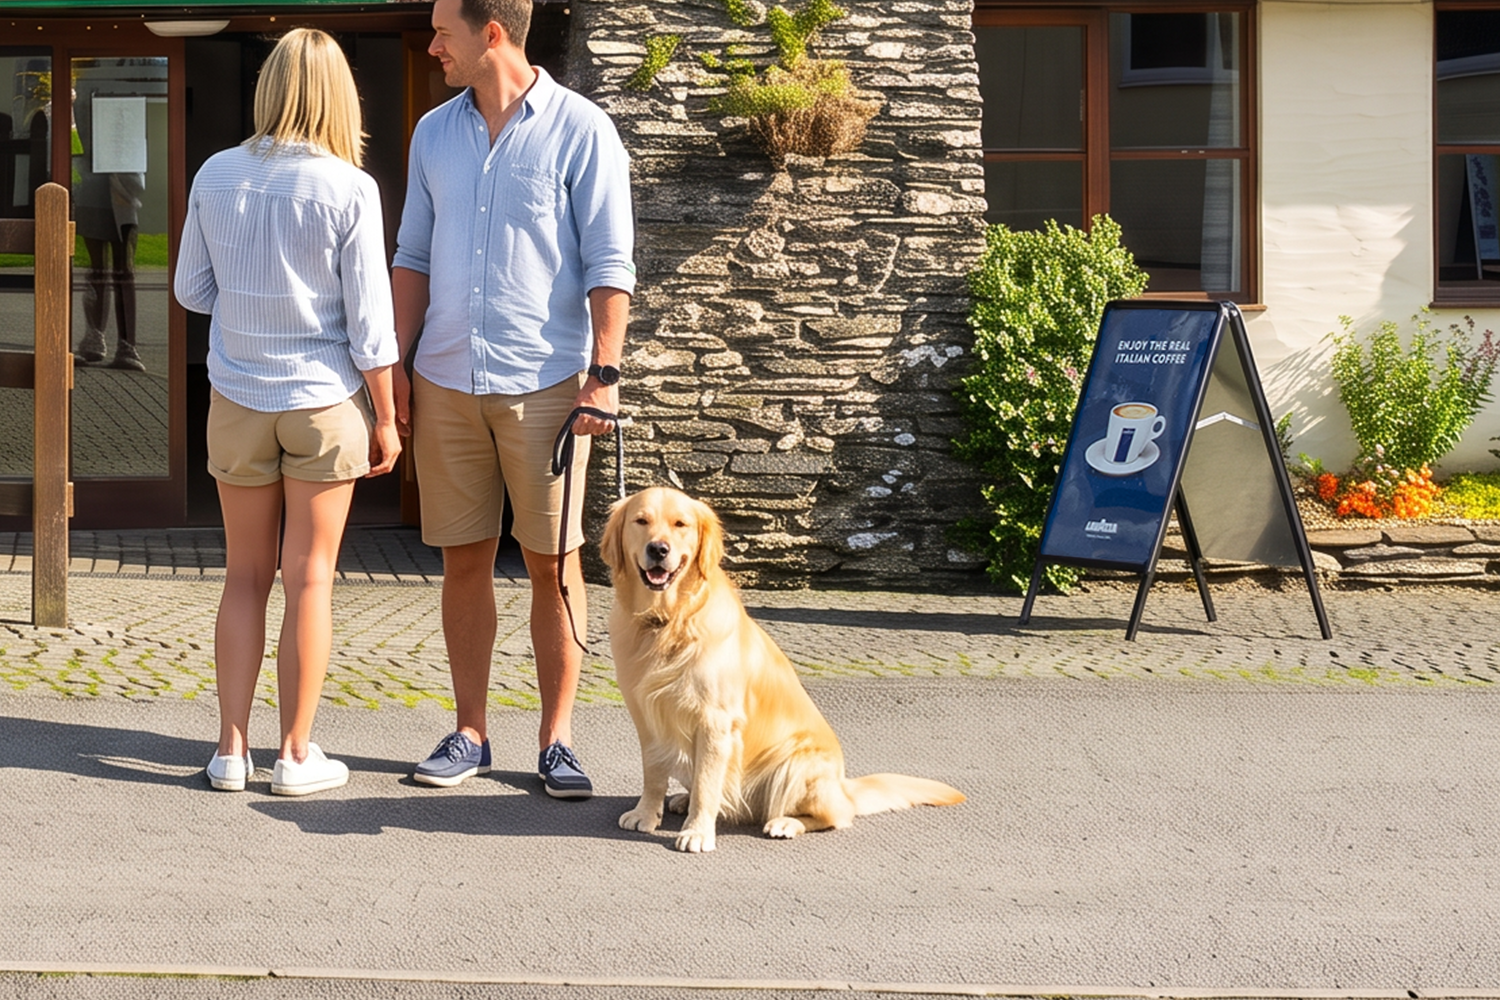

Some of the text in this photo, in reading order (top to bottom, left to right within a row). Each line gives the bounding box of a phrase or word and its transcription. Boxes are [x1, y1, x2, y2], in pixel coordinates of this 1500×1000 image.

[1117, 340, 1191, 351] ENJOY THE REAL
[1114, 353, 1187, 364] ITALIAN COFFEE
